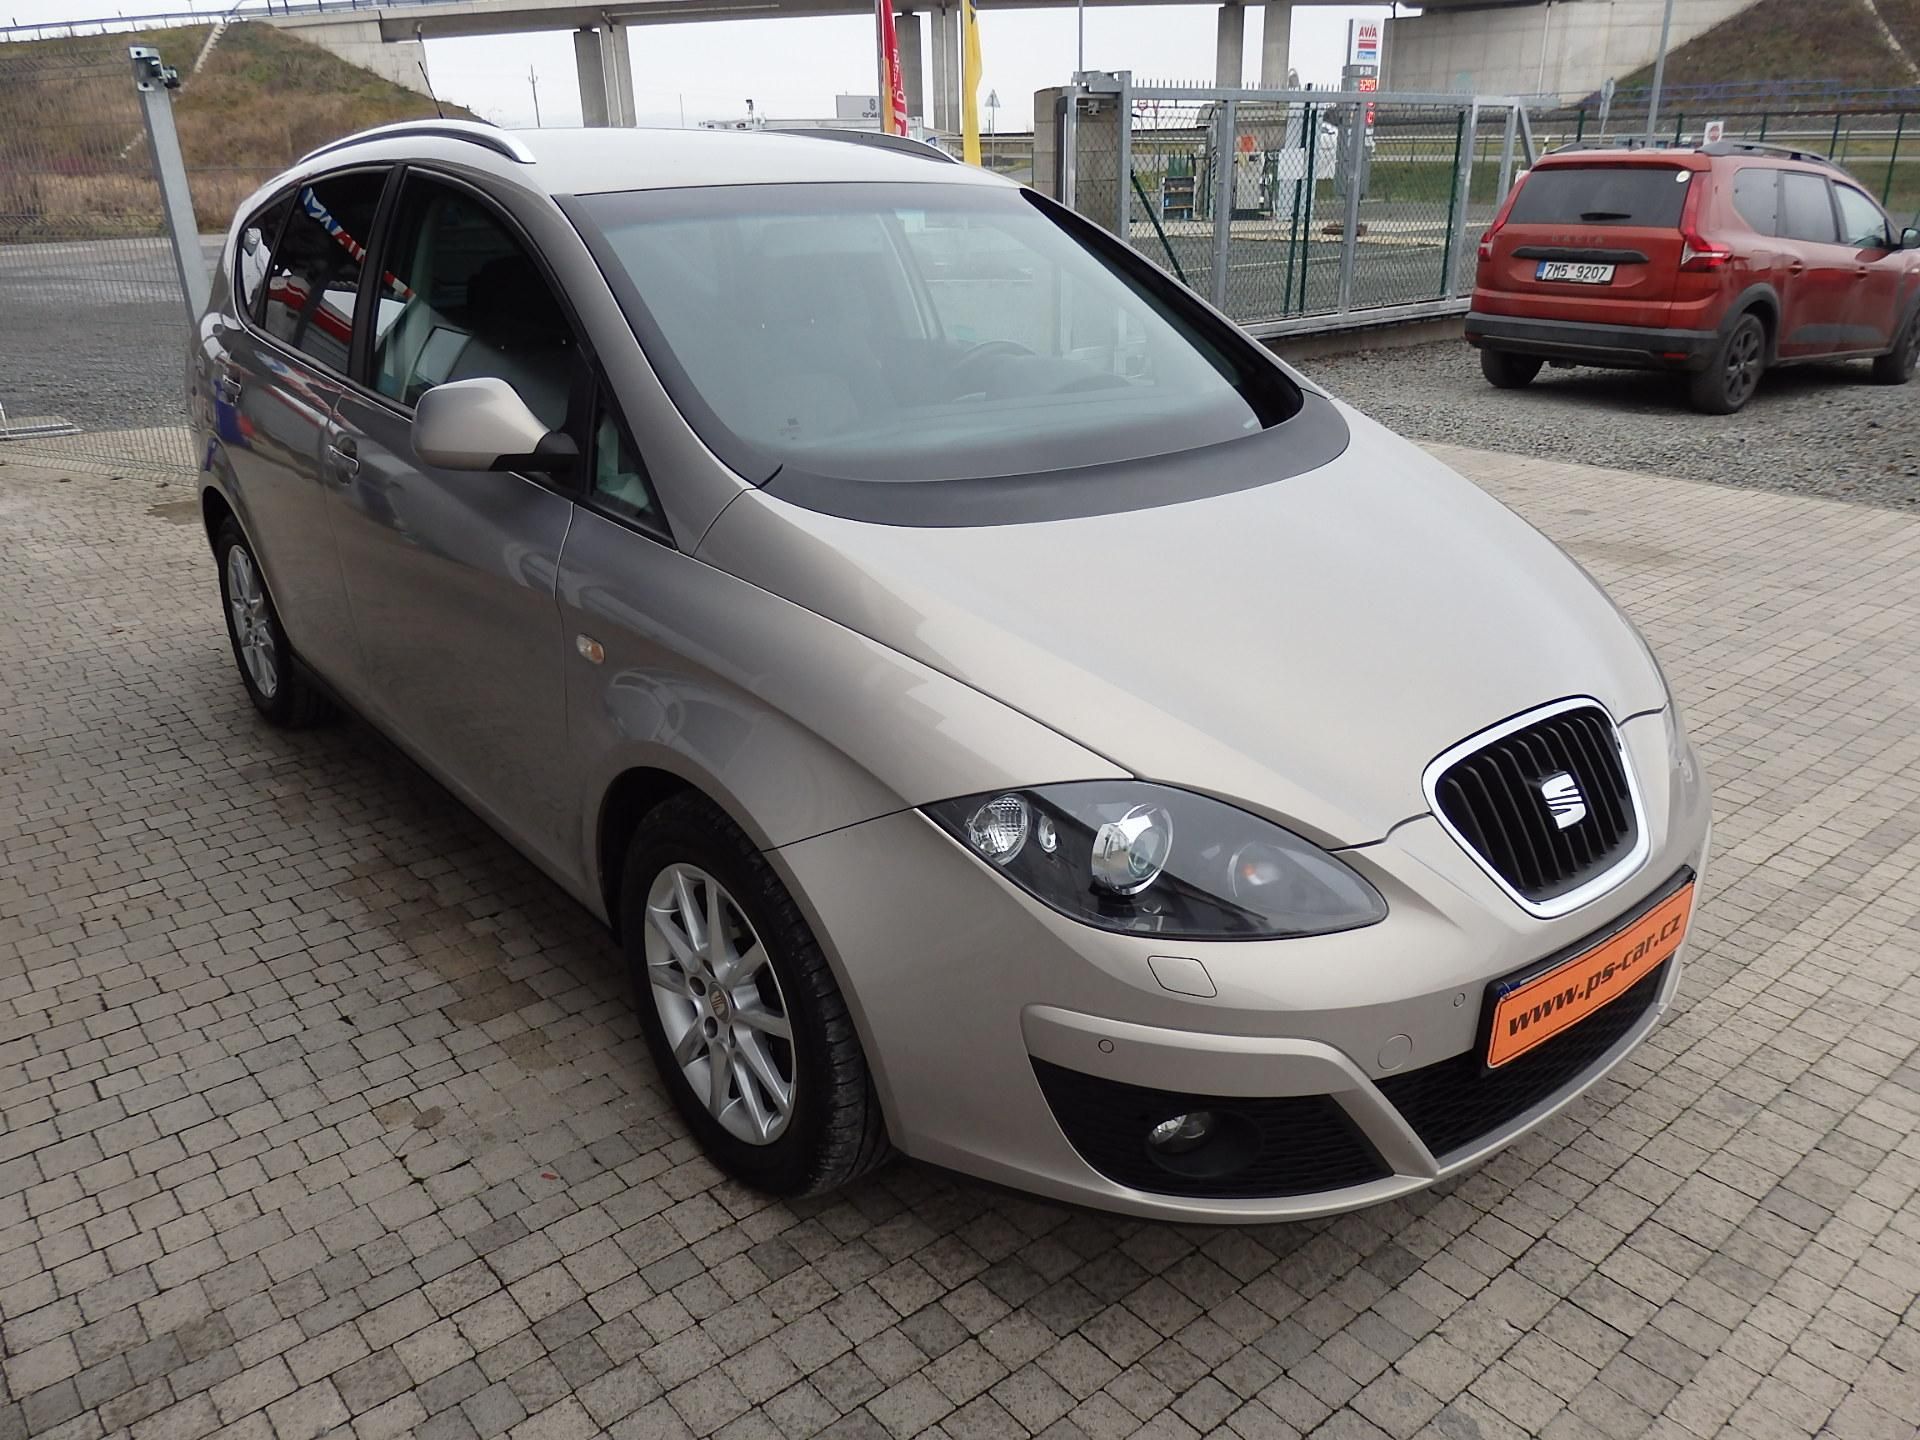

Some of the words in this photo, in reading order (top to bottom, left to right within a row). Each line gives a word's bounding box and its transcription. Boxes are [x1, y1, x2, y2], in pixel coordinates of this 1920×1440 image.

[1358, 24, 1377, 38] AVIA
[1545, 263, 1569, 278] 7M5
[1575, 265, 1609, 280] 9207
[1508, 912, 1682, 1037] www.ps-car.cz
